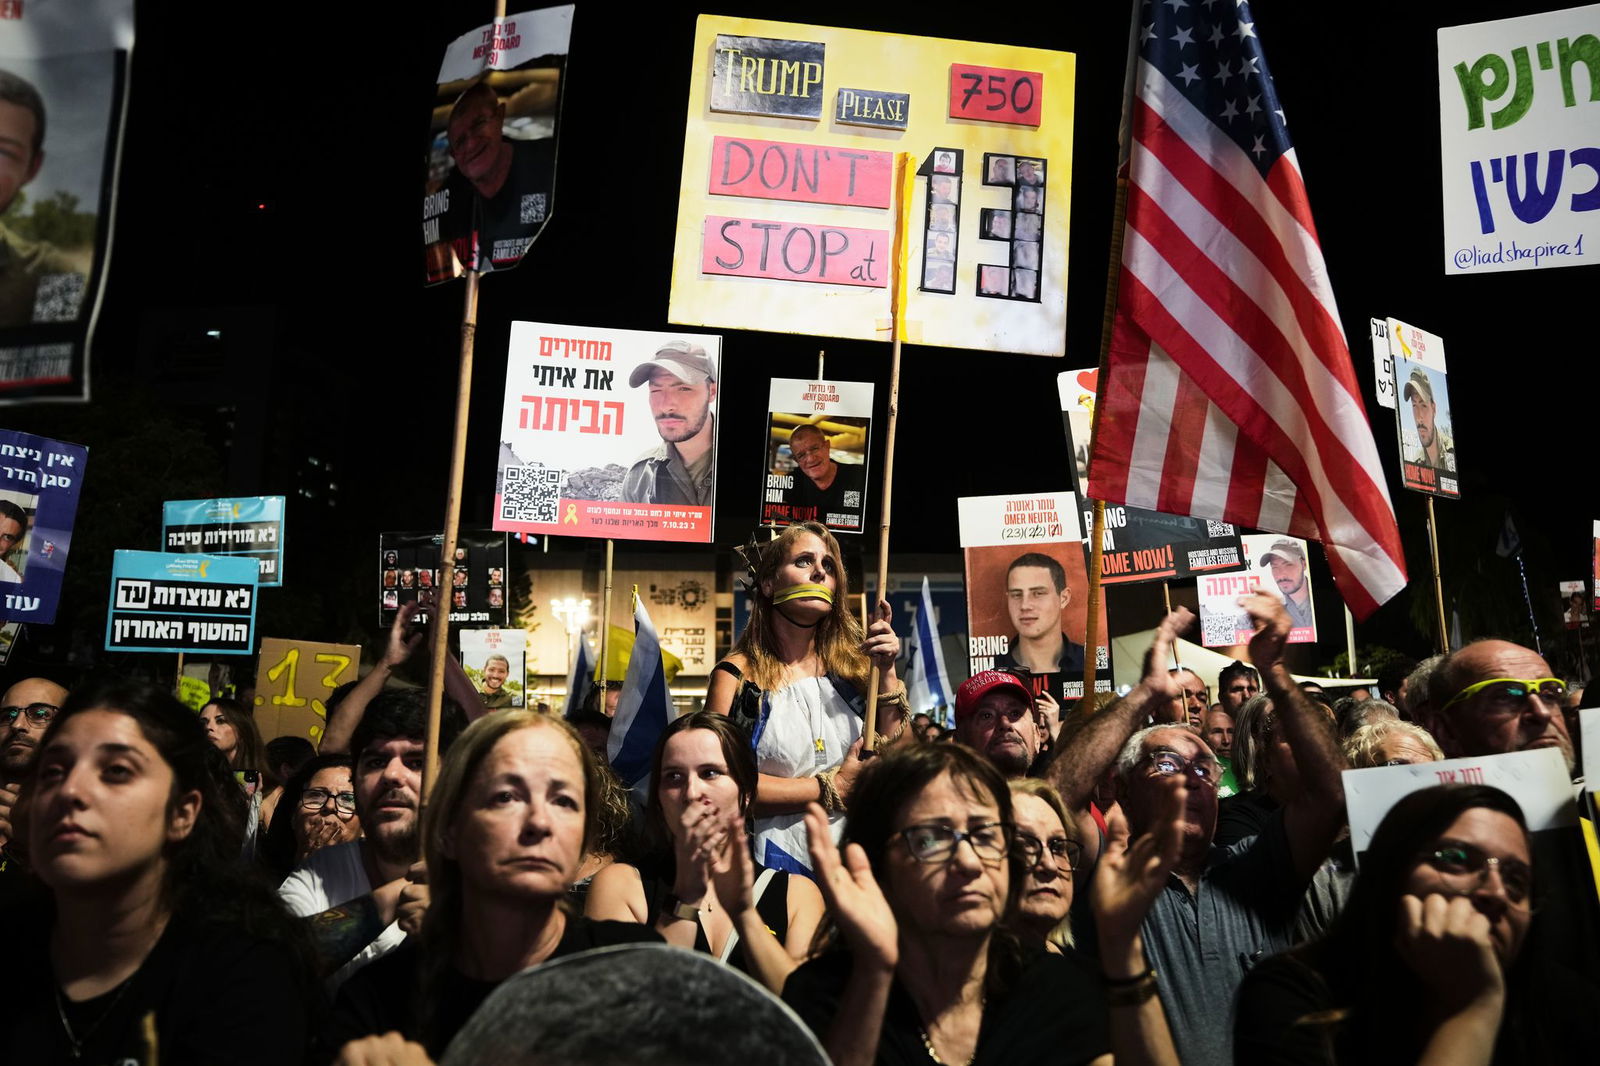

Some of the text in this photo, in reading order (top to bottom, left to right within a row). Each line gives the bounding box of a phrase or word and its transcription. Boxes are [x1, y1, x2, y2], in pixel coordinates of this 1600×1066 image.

[720, 48, 822, 98] TRUMP
[960, 72, 1034, 114] 750
[840, 90, 904, 122] PLEASE
[720, 140, 868, 197] DON'T
[422, 188, 450, 220] BRING
[422, 217, 440, 245] HIM
[916, 146, 1047, 303] 13
[716, 220, 878, 282] STOP at
[1454, 234, 1584, 269] @liadshapira1
[540, 336, 612, 361] מחזירים
[532, 364, 614, 391] את איתי
[519, 395, 625, 436] הביתה
[0, 444, 75, 468] אין ניצח
[2, 466, 71, 488] סגן הדר
[766, 474, 794, 490] BRING
[766, 489, 784, 503] HIM
[1006, 498, 1055, 512] עומר נאוטרה
[764, 504, 790, 518] HOME
[1004, 512, 1058, 526] OMER NEUTRA
[1084, 506, 1127, 530] BING
[204, 528, 256, 545] מורידות
[258, 526, 277, 544] לא
[662, 521, 688, 530] 7.10.23
[259, 560, 276, 574] עד
[1101, 544, 1175, 575] OME NOW!
[1189, 556, 1216, 568] FAMILIES
[1218, 554, 1240, 565] FORUM
[5, 594, 40, 612] עוז
[120, 585, 250, 608] לא עוצרות עד
[448, 612, 470, 621] שלנ
[114, 619, 248, 642] החטוף האחרון
[969, 636, 1008, 657] BRING
[1063, 688, 1084, 698] FAMILI
